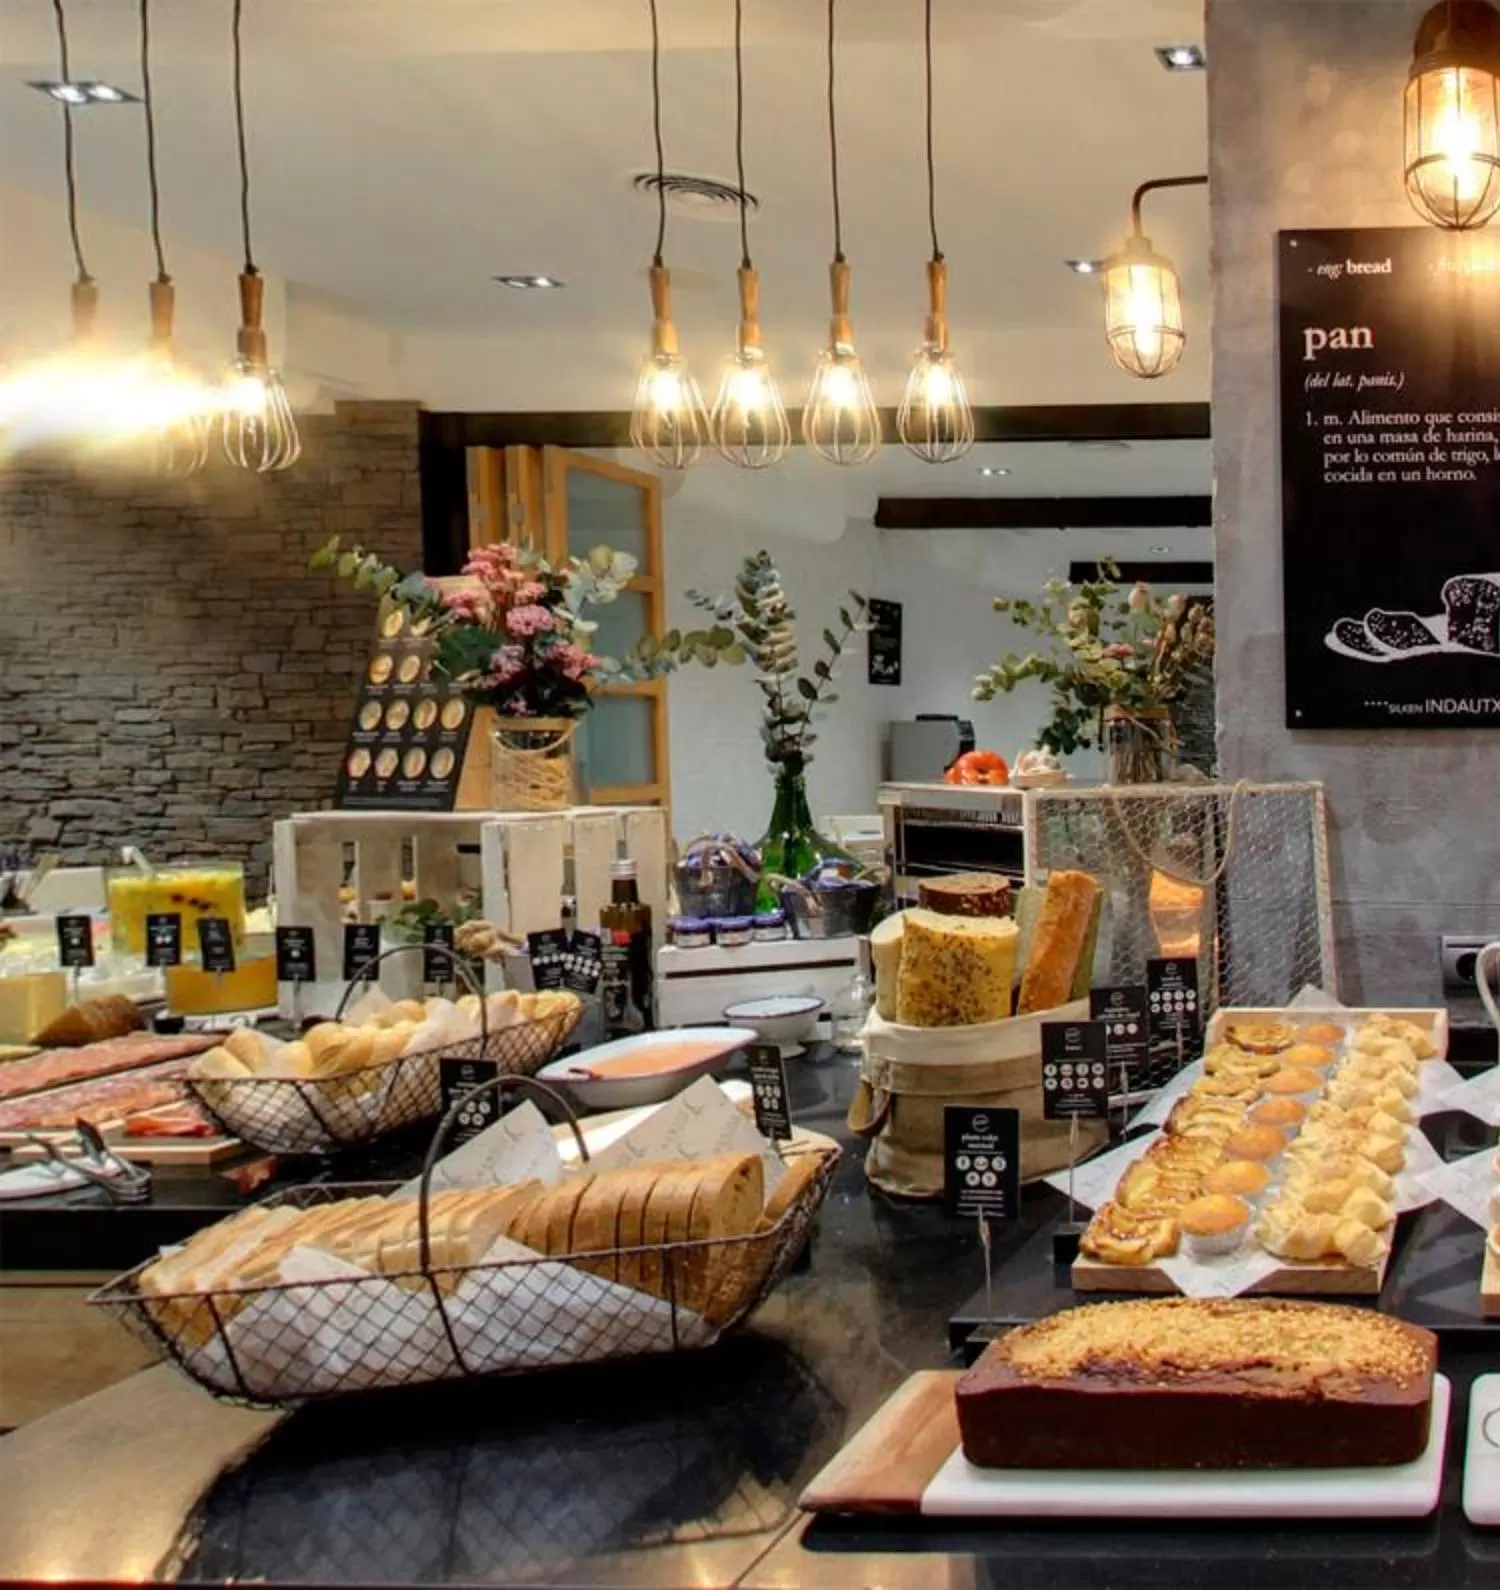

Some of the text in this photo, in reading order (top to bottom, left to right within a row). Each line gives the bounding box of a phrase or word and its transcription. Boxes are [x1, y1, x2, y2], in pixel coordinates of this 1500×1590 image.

[1346, 257, 1393, 275] bread
[1303, 326, 1374, 361] pan
[1304, 370, 1405, 393] (del lat. panis.)
[1306, 409, 1319, 427] 1.
[1323, 414, 1343, 426] m.
[1347, 409, 1420, 425] Alimento
[1424, 412, 1454, 430] que
[1323, 427, 1499, 445] en una masa de harina,
[1323, 451, 1351, 469] por
[1354, 447, 1369, 463] lo
[1372, 447, 1425, 463] común
[1428, 446, 1448, 462] de
[1451, 446, 1490, 467] trigo,
[1323, 465, 1477, 482] cocida en un horno.
